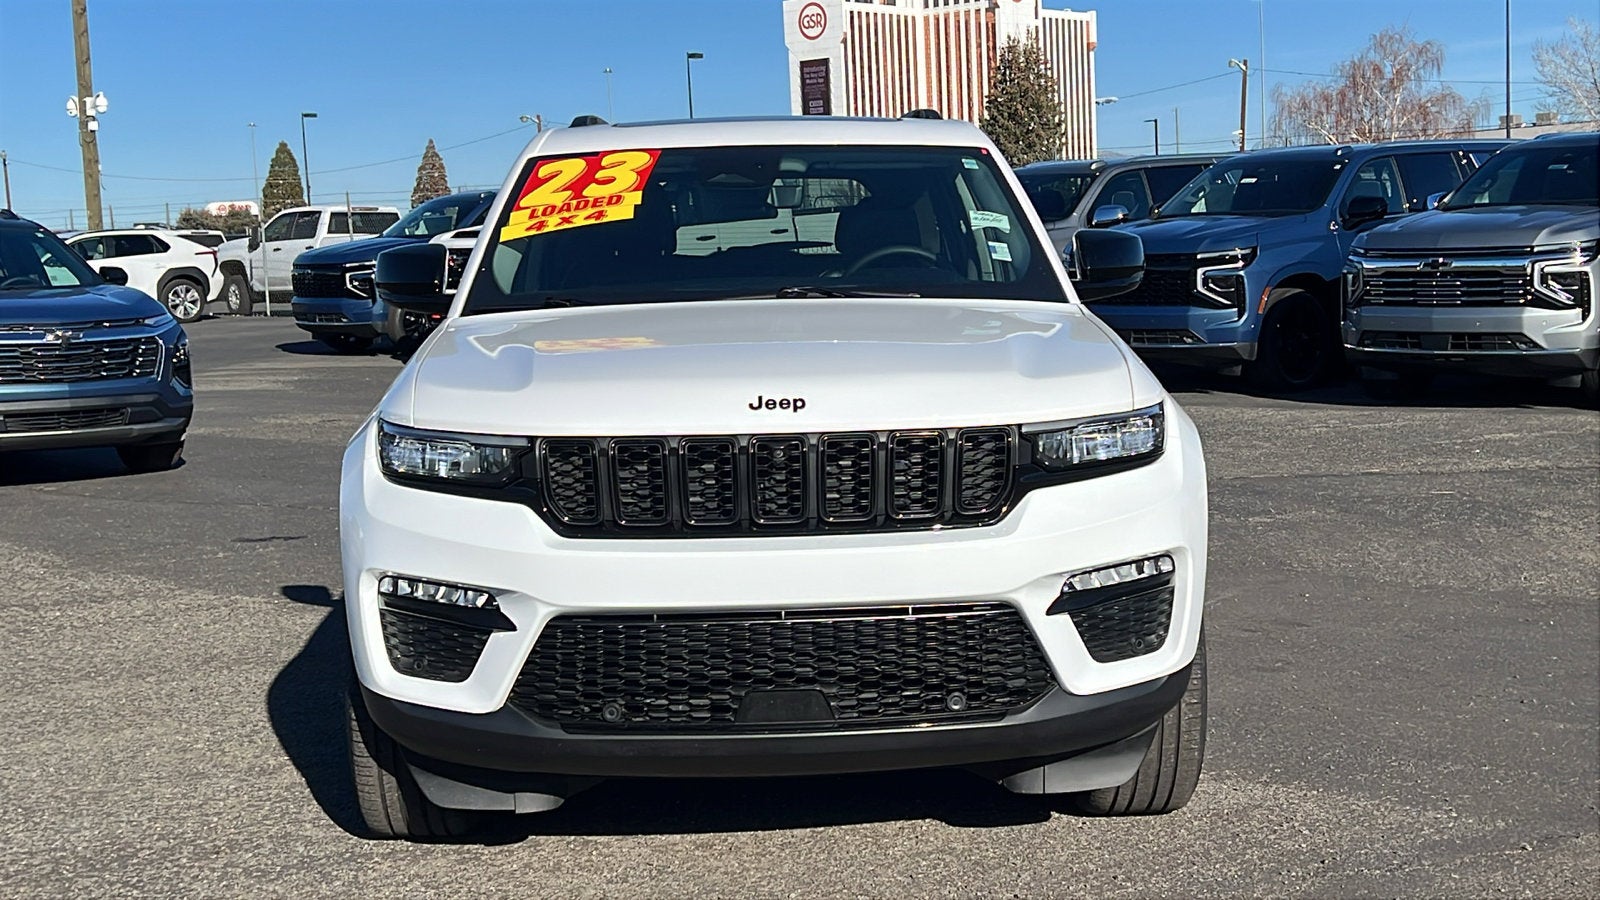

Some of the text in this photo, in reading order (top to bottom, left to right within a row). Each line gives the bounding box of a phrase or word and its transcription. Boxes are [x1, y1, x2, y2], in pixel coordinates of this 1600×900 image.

[802, 13, 822, 29] GSR
[519, 151, 653, 208] 23
[528, 194, 624, 221] LOADED
[748, 395, 806, 413] Jeep
